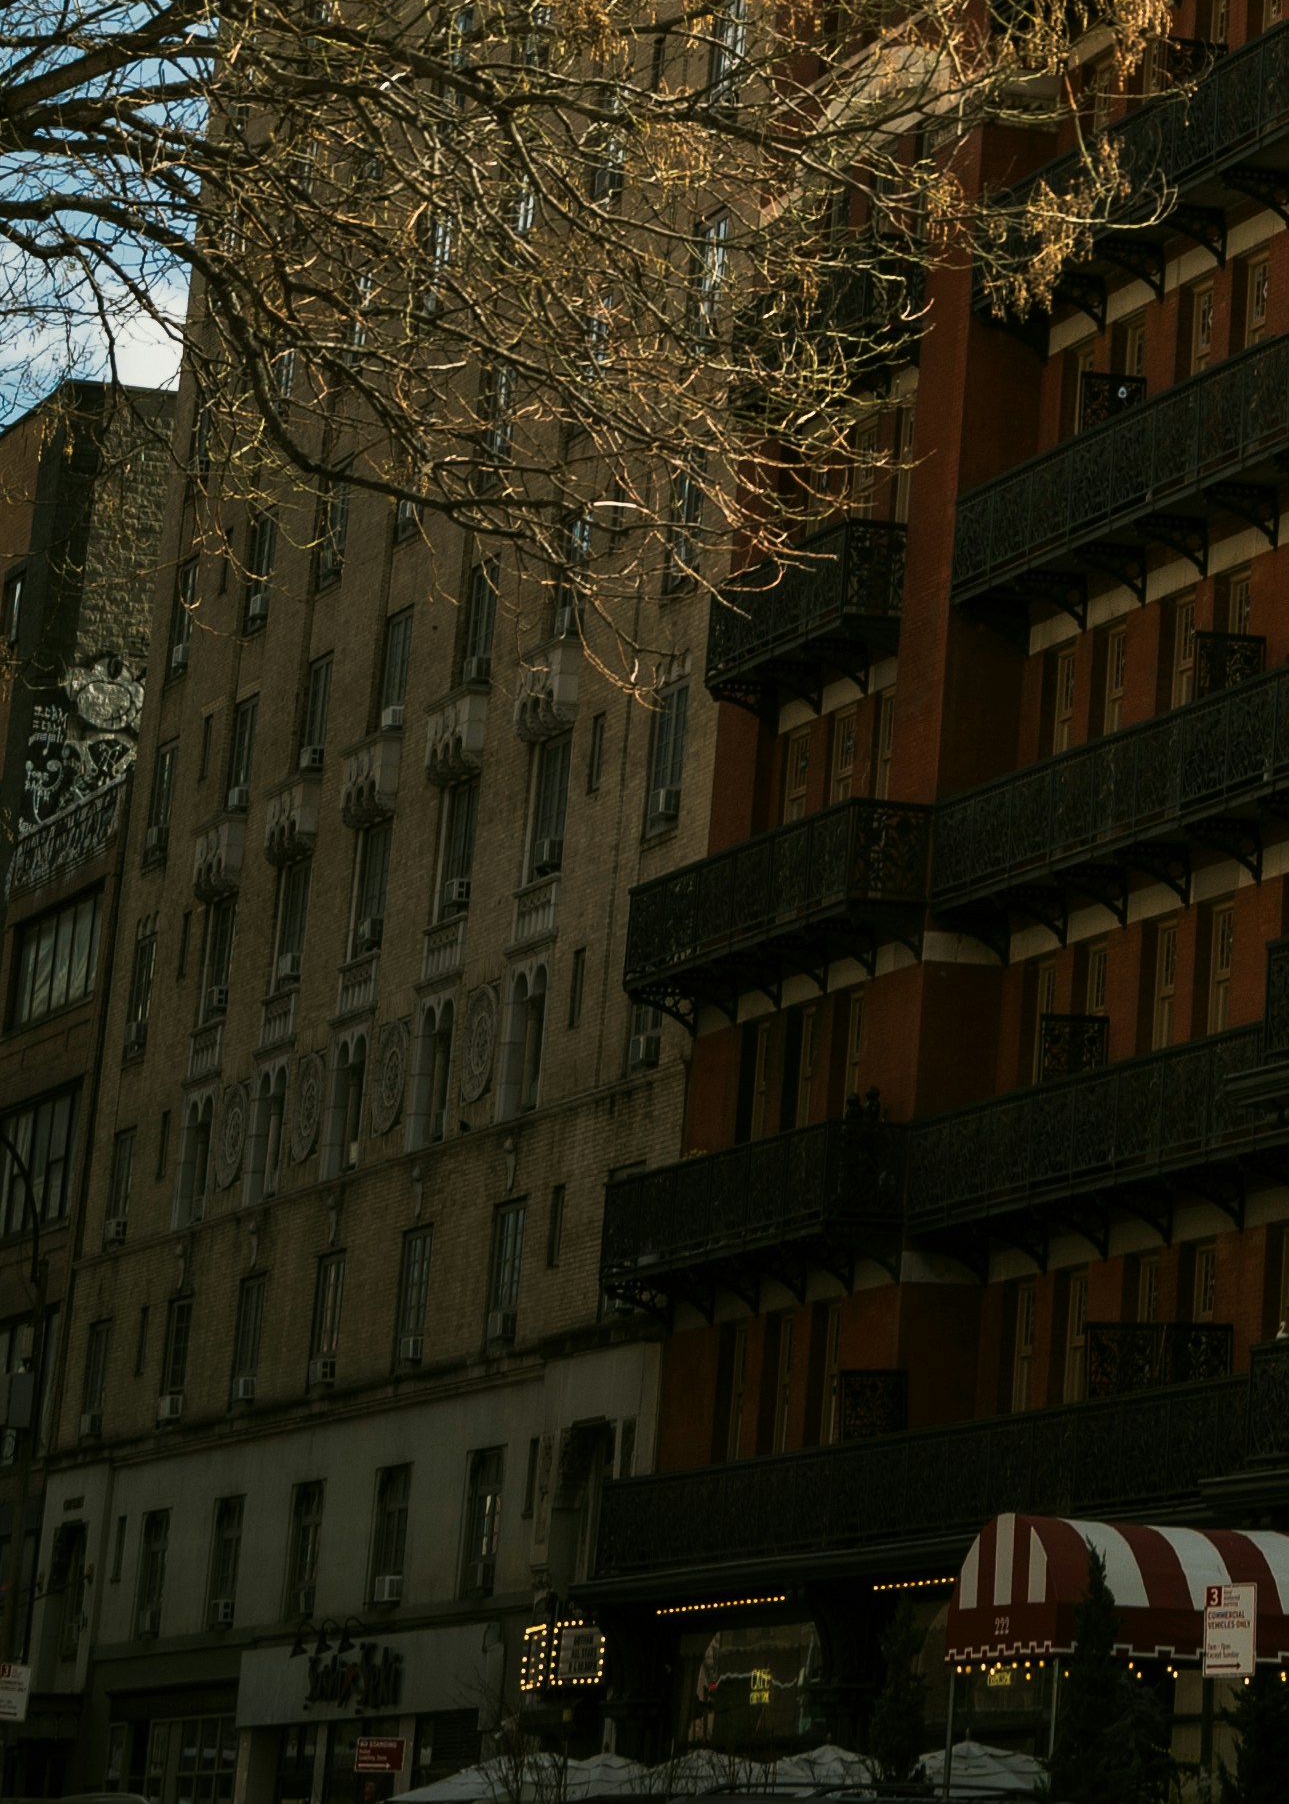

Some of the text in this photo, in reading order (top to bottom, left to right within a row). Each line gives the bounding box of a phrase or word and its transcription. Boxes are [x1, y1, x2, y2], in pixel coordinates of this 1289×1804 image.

[1209, 1588, 1219, 1606] 3
[994, 1616, 1010, 1636] 222
[1207, 1619, 1251, 1630] VEHICLES ONLY
